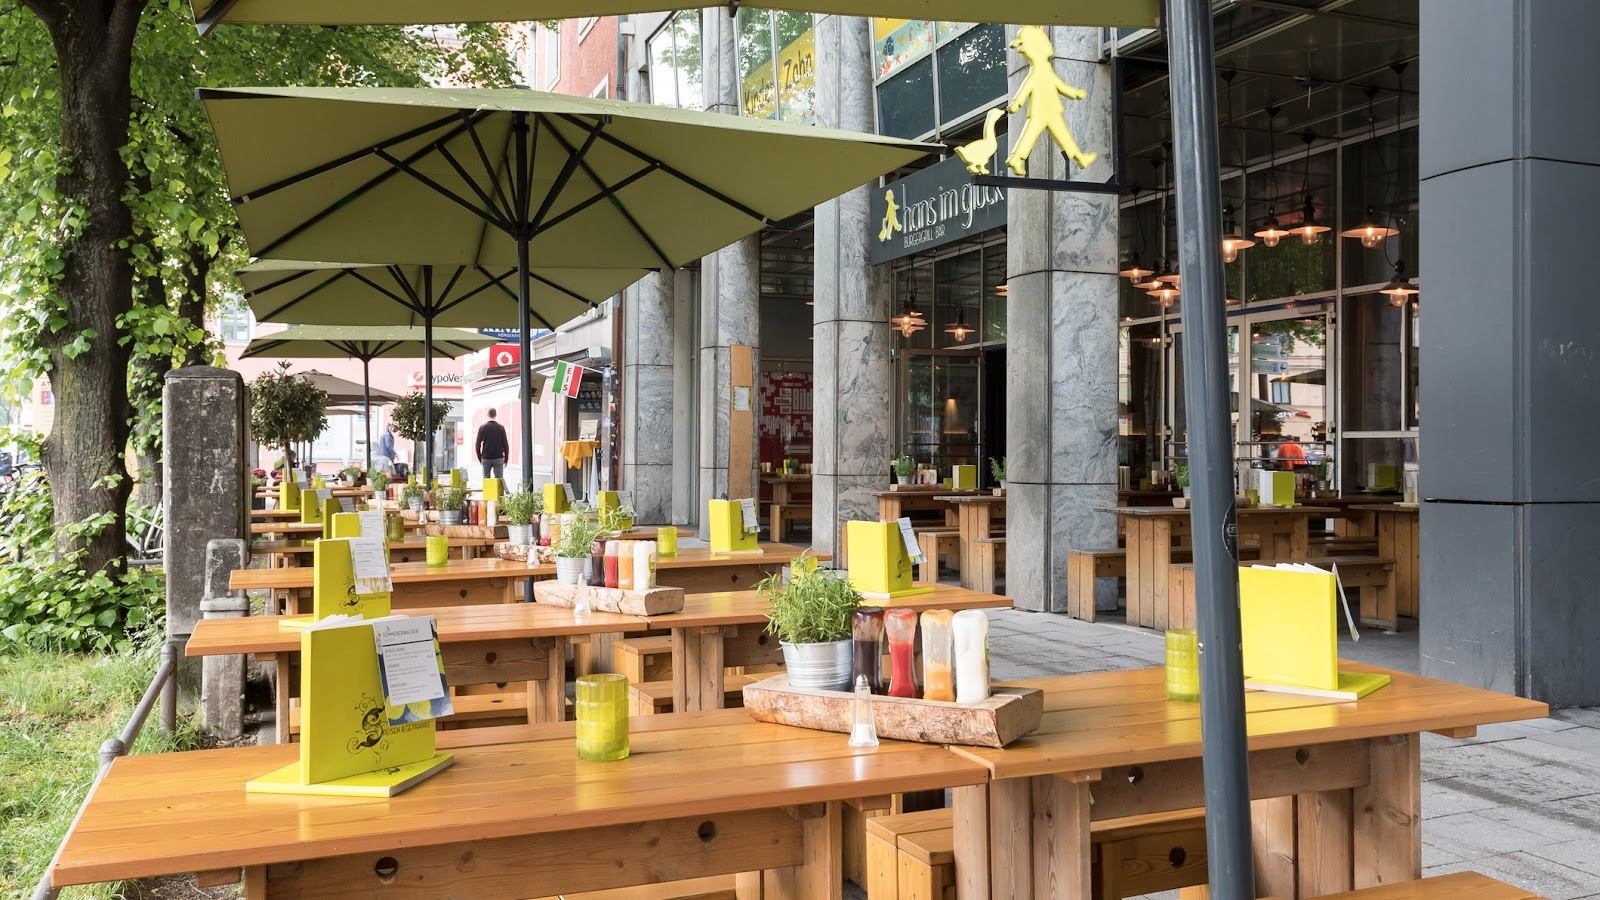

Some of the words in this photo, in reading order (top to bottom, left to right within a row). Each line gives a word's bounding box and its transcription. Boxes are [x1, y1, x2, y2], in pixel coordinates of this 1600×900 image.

[902, 183, 937, 234] hans
[939, 186, 959, 221] im
[563, 367, 572, 391] EIS
